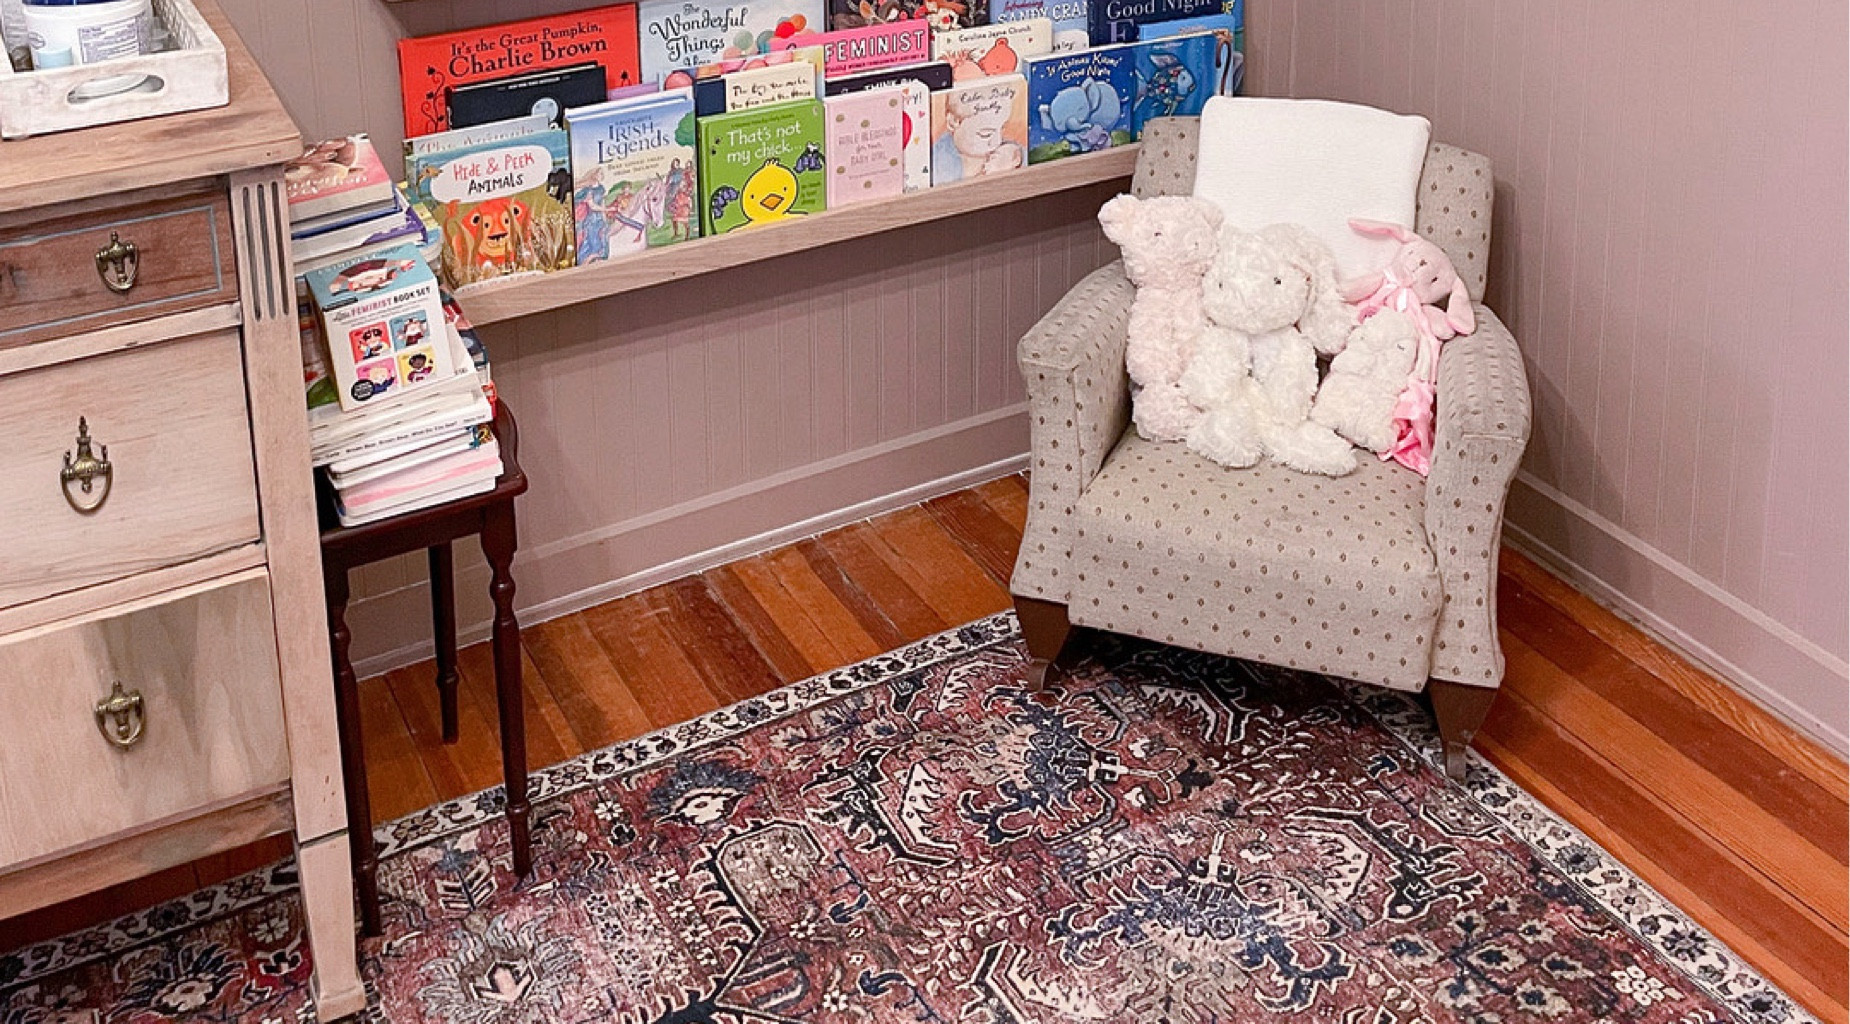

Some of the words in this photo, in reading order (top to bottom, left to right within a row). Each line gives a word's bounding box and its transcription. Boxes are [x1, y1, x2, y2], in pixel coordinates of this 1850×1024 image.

[649, 7, 749, 42] Wonderful
[451, 42, 472, 56] It's
[475, 38, 496, 53] the
[499, 30, 539, 49] Great
[665, 36, 725, 63] Things
[824, 29, 925, 64] FEMINIST
[448, 47, 534, 77] Charlie
[539, 37, 608, 62] Brown
[1061, 67, 1085, 83] Good
[608, 120, 654, 143] IRISH
[726, 125, 772, 149] That's
[775, 119, 802, 138] not
[598, 128, 671, 165] Legends
[727, 149, 751, 167] my
[486, 157, 500, 174] &
[504, 152, 536, 172] PEEK
[393, 291, 415, 304] BOOK
[415, 285, 431, 297] SET
